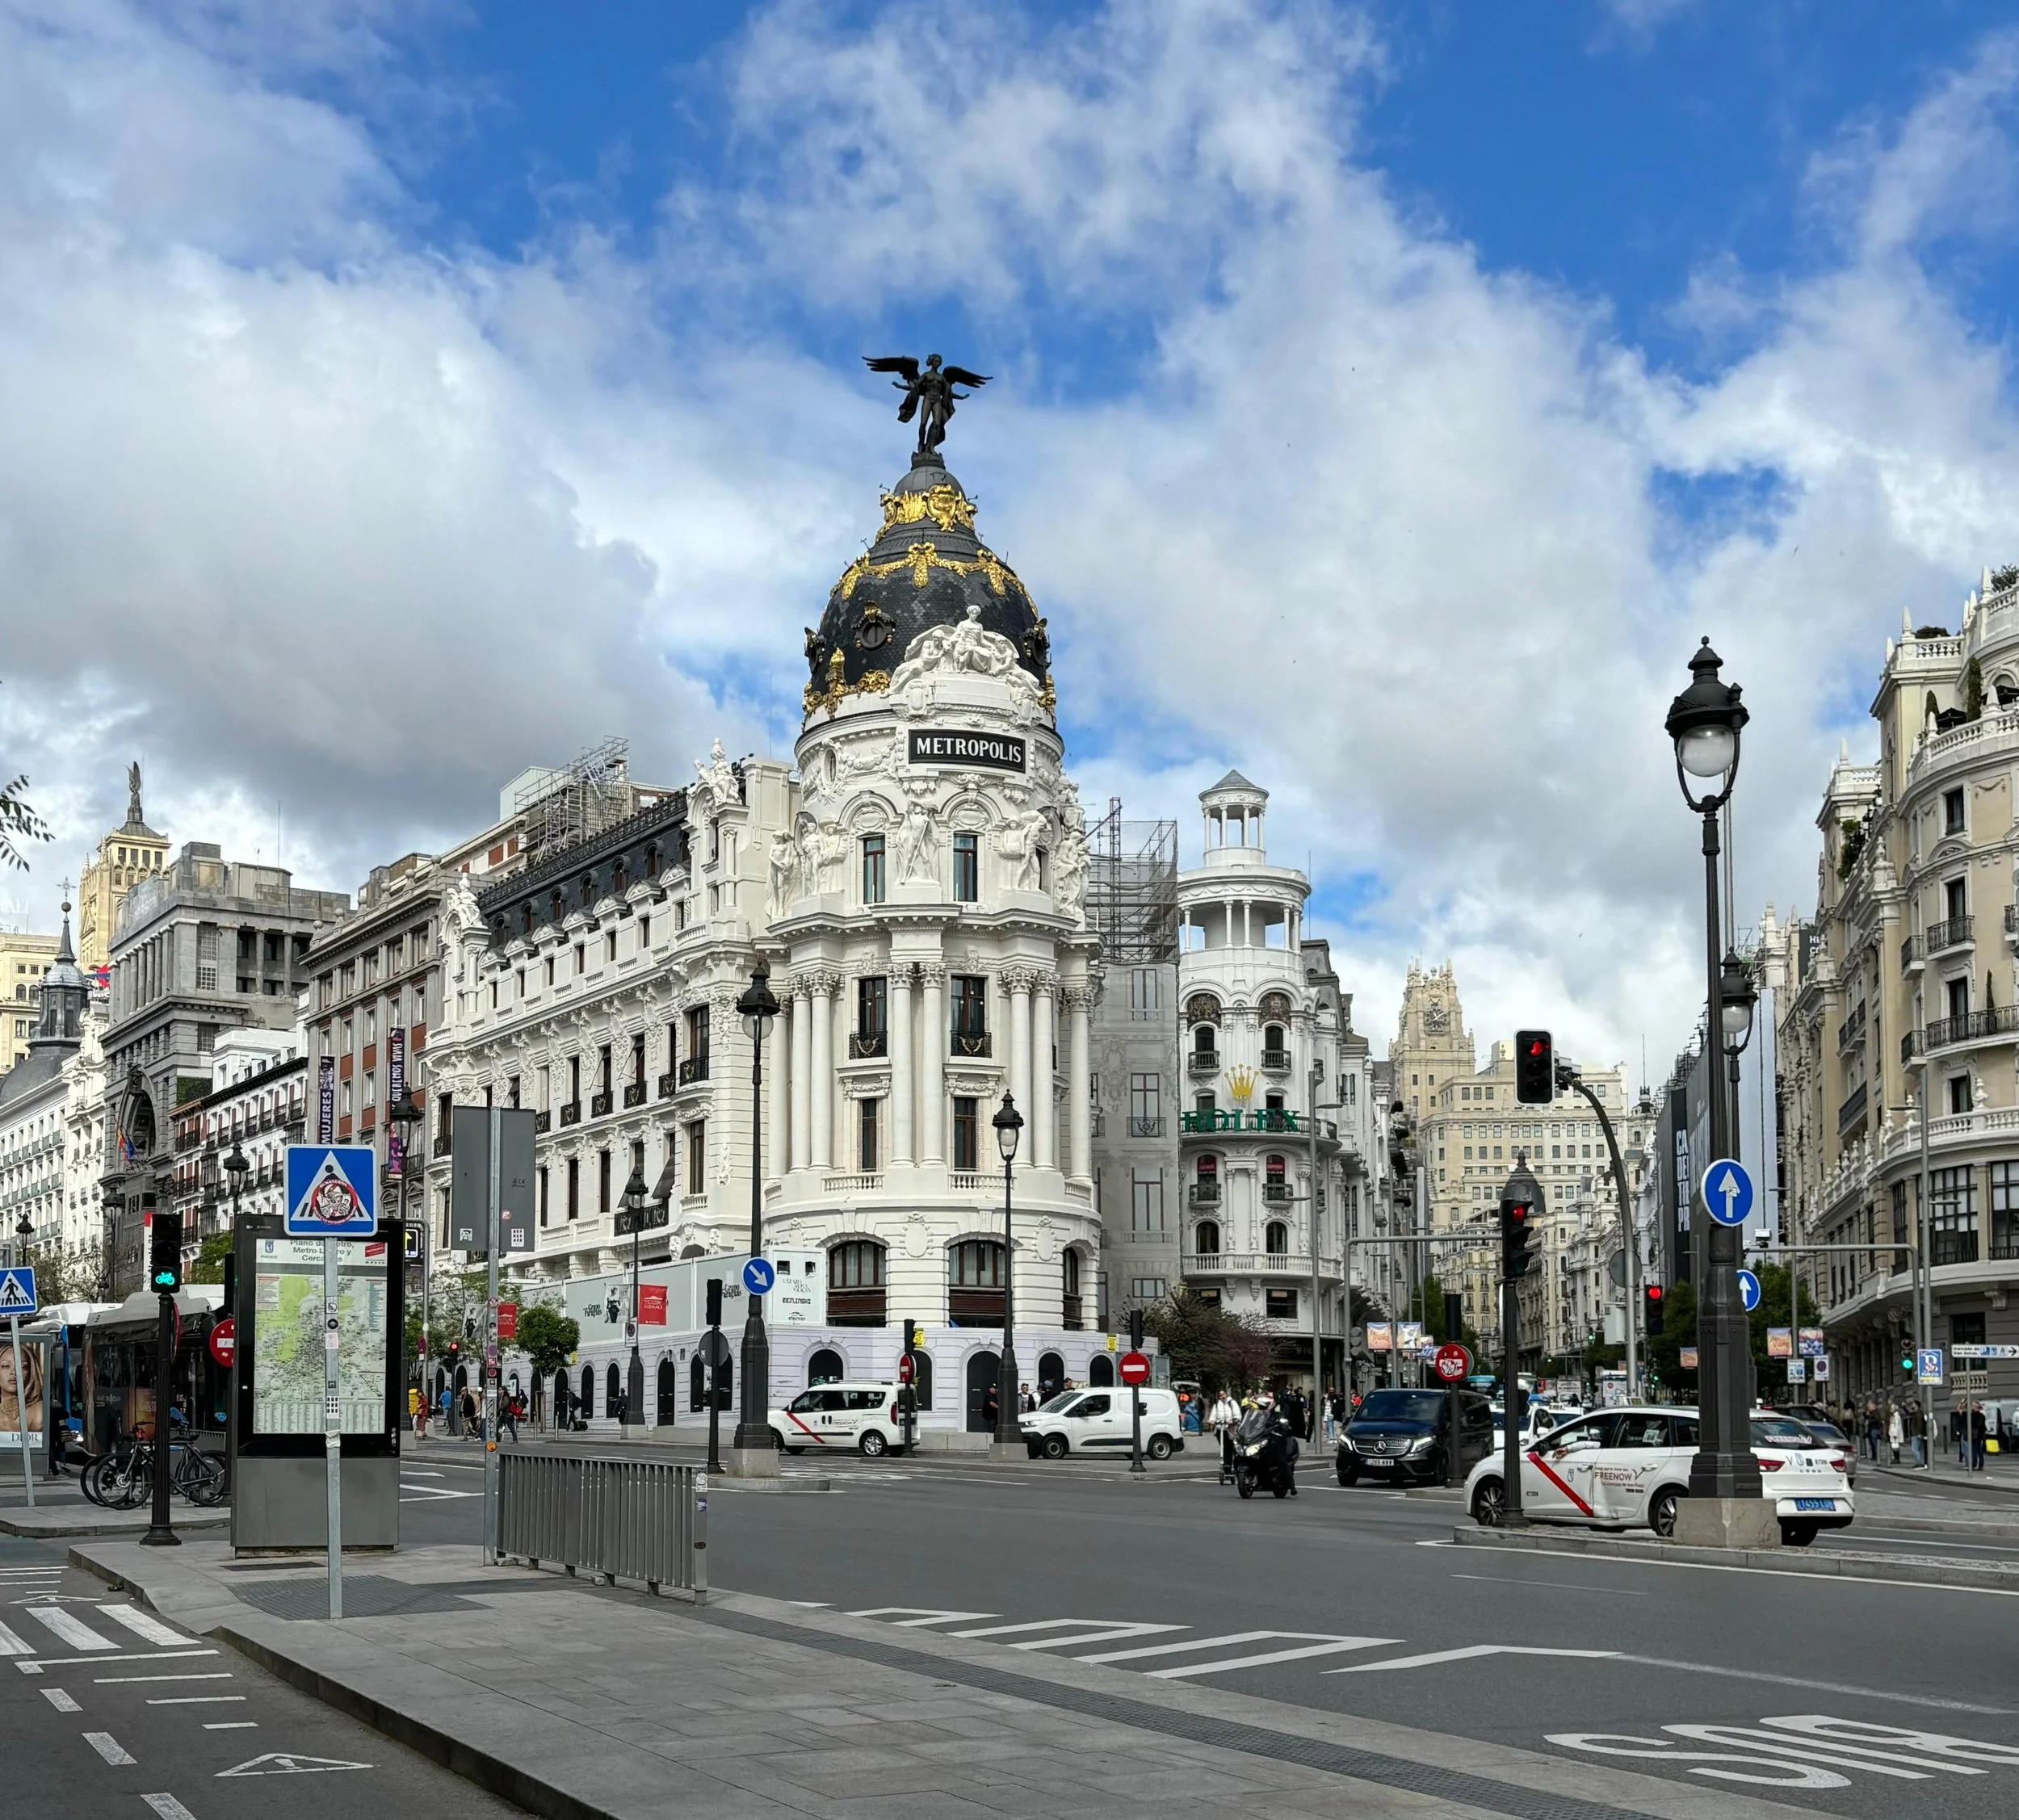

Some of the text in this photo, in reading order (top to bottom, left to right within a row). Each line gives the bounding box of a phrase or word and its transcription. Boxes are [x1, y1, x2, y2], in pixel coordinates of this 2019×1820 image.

[917, 737, 1022, 763] METROPOLIS
[321, 1091, 332, 1144] MUJERES
[1182, 1108, 1302, 1133] ROLEX
[1595, 1471, 1632, 1481] FREENOW
